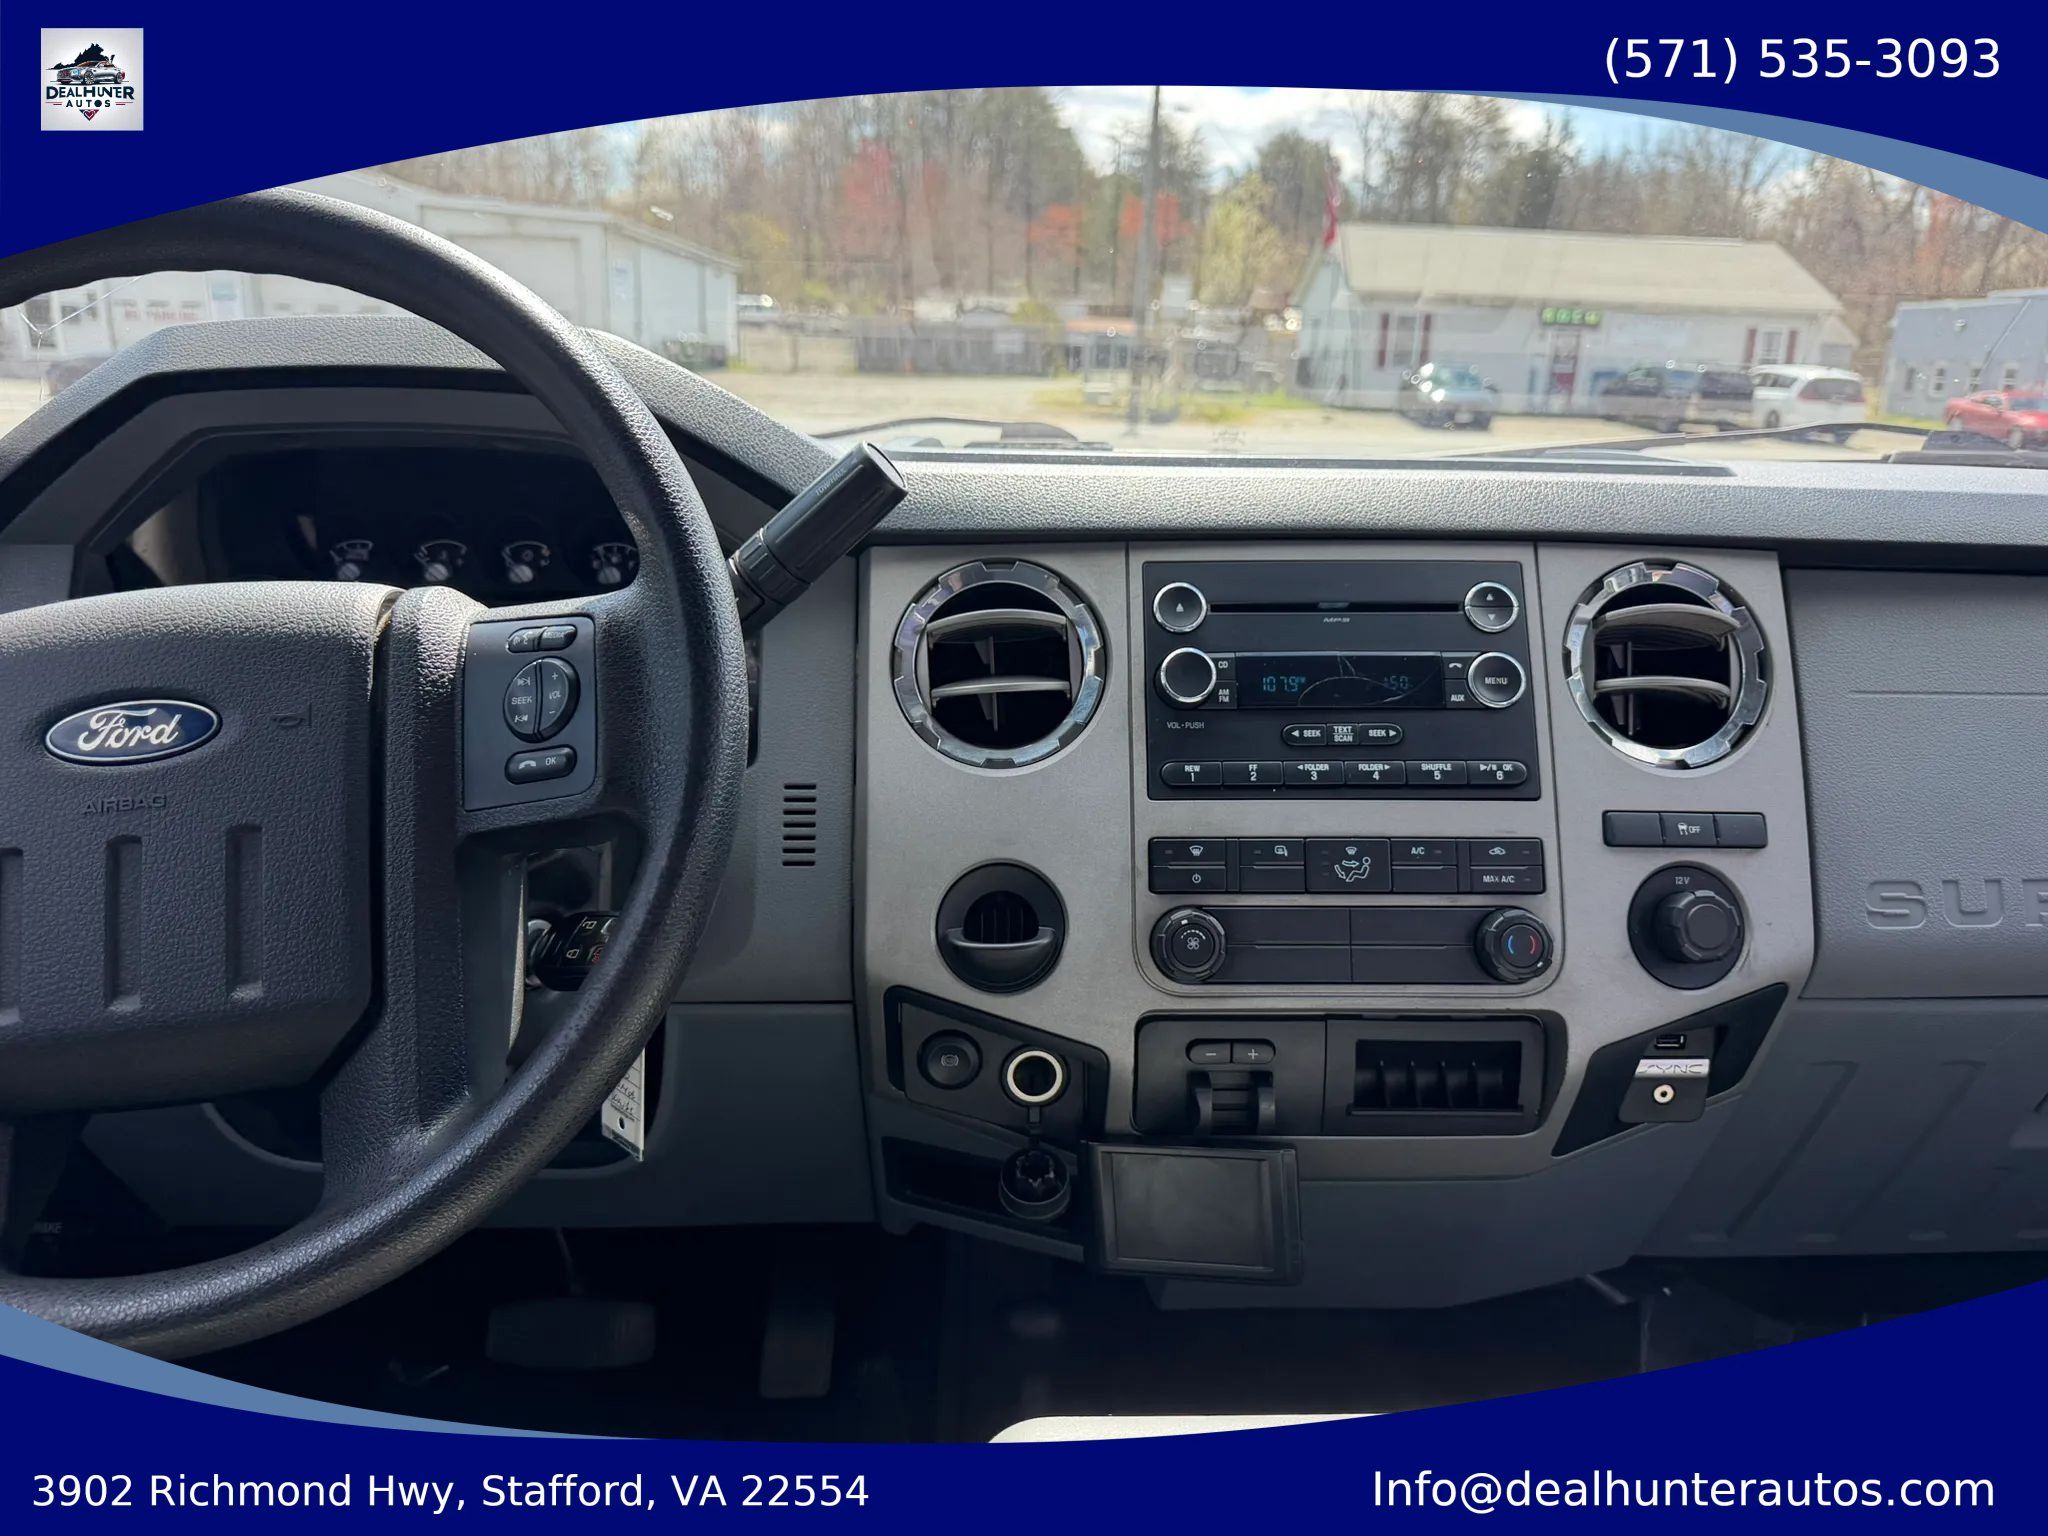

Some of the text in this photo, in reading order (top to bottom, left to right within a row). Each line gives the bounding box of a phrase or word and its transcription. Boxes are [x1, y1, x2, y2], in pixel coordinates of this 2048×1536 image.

[1218, 661, 1229, 669] CD
[1262, 676, 1299, 692] 107.9
[1485, 677, 1508, 685] MENU
[512, 696, 532, 705] SEEK
[1450, 694, 1465, 702] AUX
[77, 707, 182, 751] Ford
[1303, 729, 1321, 737] SEEK
[1333, 725, 1352, 733] TEXT
[1368, 729, 1387, 737] SEEK
[1333, 734, 1353, 742] SCAN
[545, 757, 557, 766] OK
[1184, 764, 1201, 773] REW
[1248, 763, 1258, 772] FF
[1304, 763, 1330, 772] FOLDER
[1358, 763, 1384, 772] FOLDER
[1421, 763, 1452, 772] SHUFFLE
[1502, 763, 1513, 771] OK
[1190, 772, 1196, 782] 1
[1250, 771, 1257, 781] 2
[1310, 771, 1318, 781] 3
[1372, 770, 1380, 781] 4
[1433, 770, 1441, 781] 5
[1496, 770, 1504, 781] 6
[83, 795, 167, 815] AIRBAG
[1688, 826, 1700, 834] OFF
[1411, 847, 1425, 855] A/C
[1482, 875, 1515, 883] MAX A/C
[1675, 877, 1690, 885] 12V
[1638, 1064, 1704, 1074] SYNC
